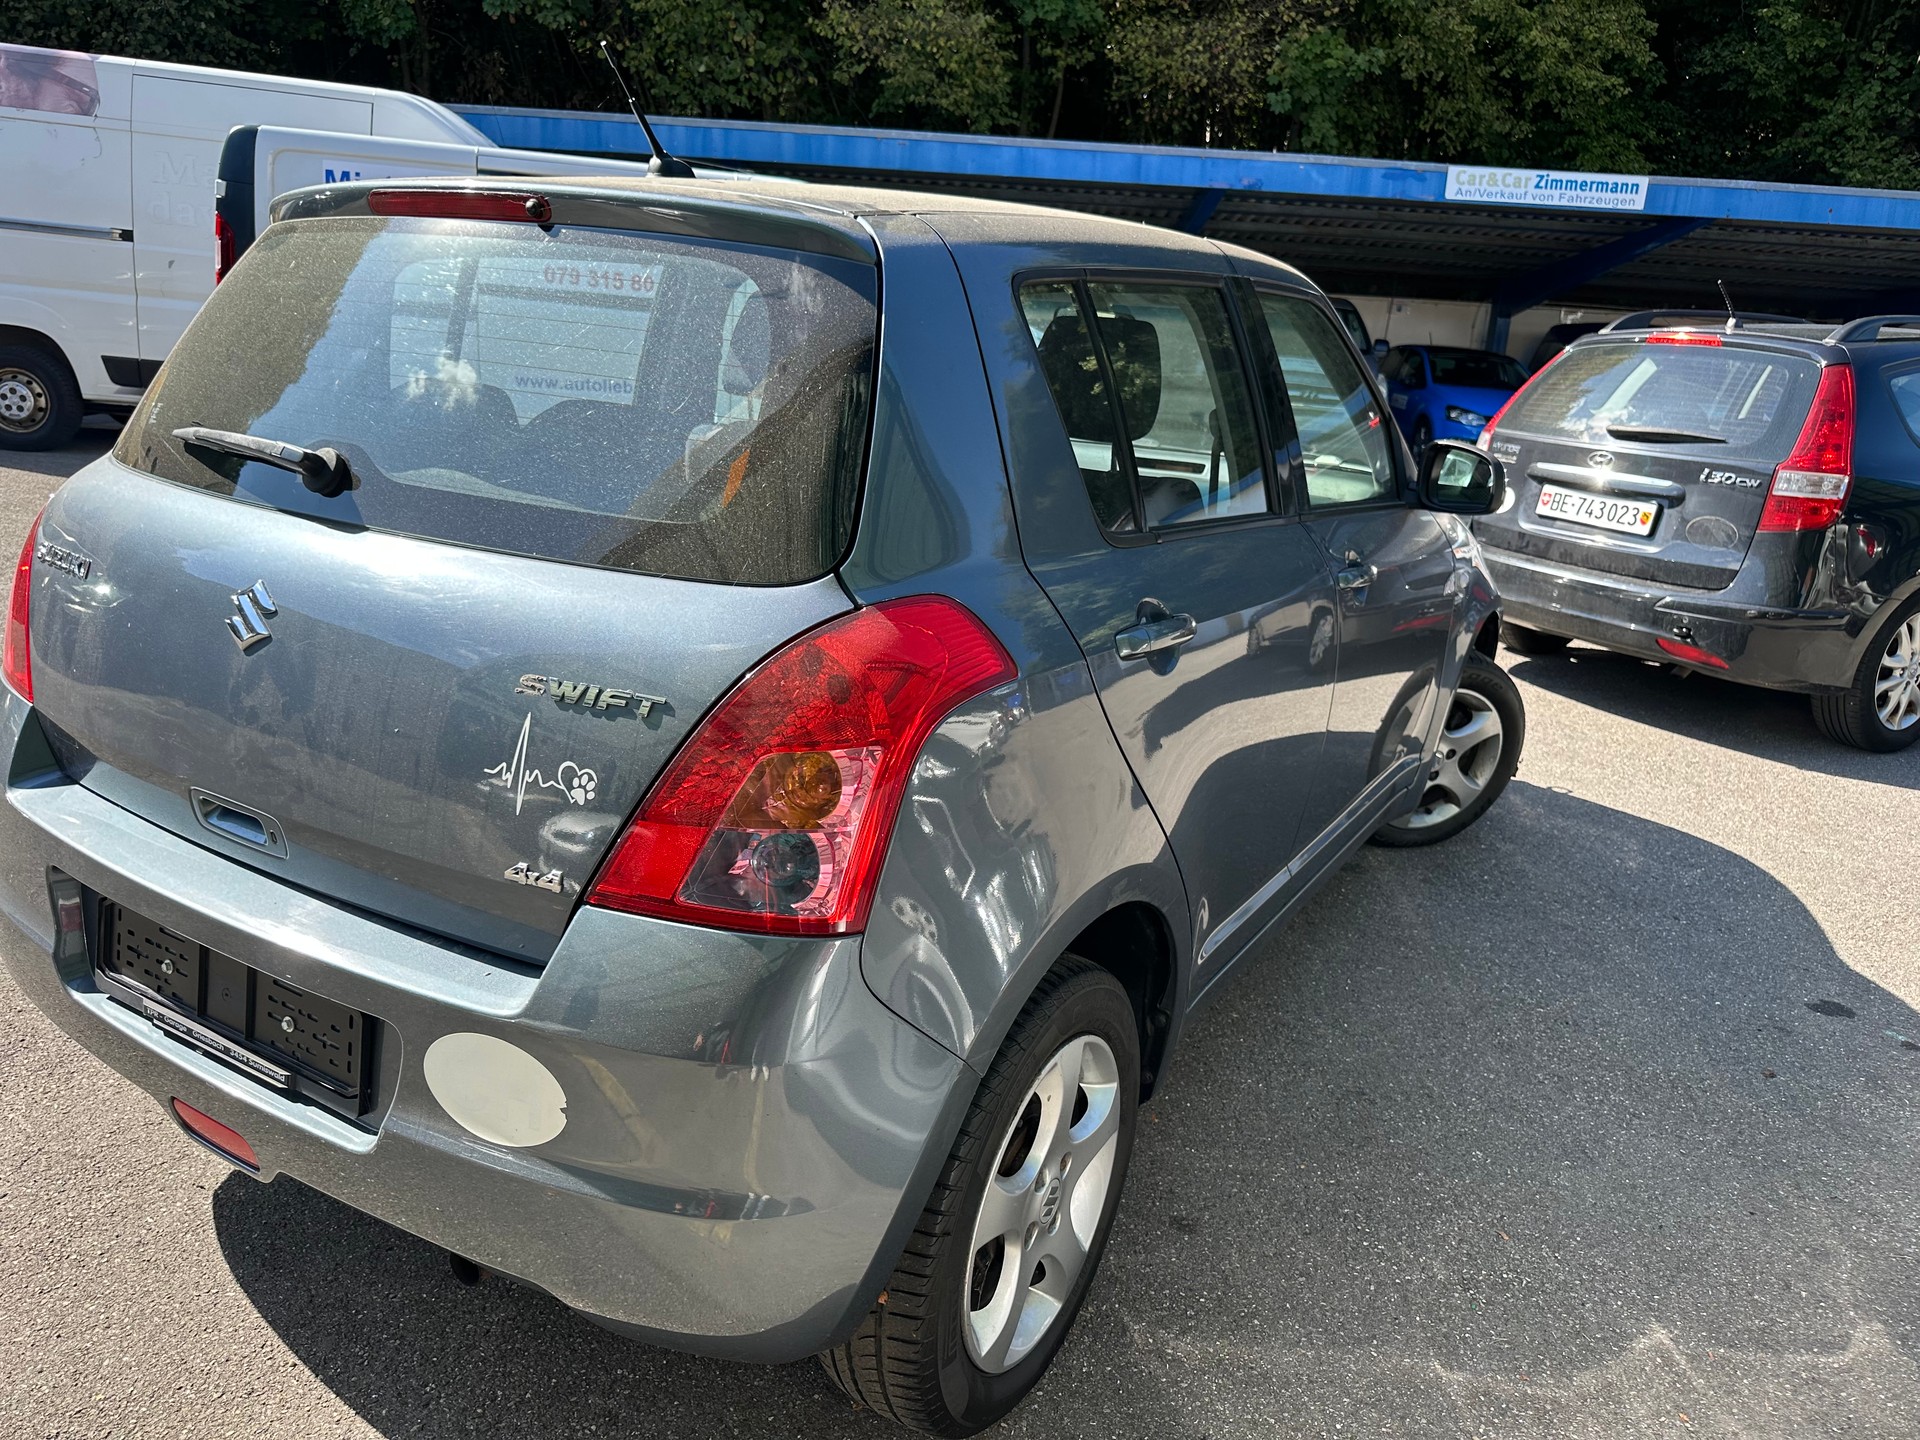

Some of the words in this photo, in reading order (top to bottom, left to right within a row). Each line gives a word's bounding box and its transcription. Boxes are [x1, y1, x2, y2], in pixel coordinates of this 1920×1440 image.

[1454, 187, 1529, 201] An/Verkauf
[1532, 193, 1554, 203] von
[1559, 194, 1636, 208] Fahrzeugen
[1455, 169, 1532, 189] Car&Car
[1534, 174, 1640, 196] Zimmermann
[543, 265, 580, 285] 079
[587, 269, 624, 290] 315
[37, 541, 93, 580] SUZUKI
[514, 673, 667, 718] SWIFT
[164, 1014, 188, 1032] Garage
[192, 1029, 225, 1051] Griesbach
[229, 1049, 248, 1063] 3454
[248, 1056, 285, 1082] Sumiswald
